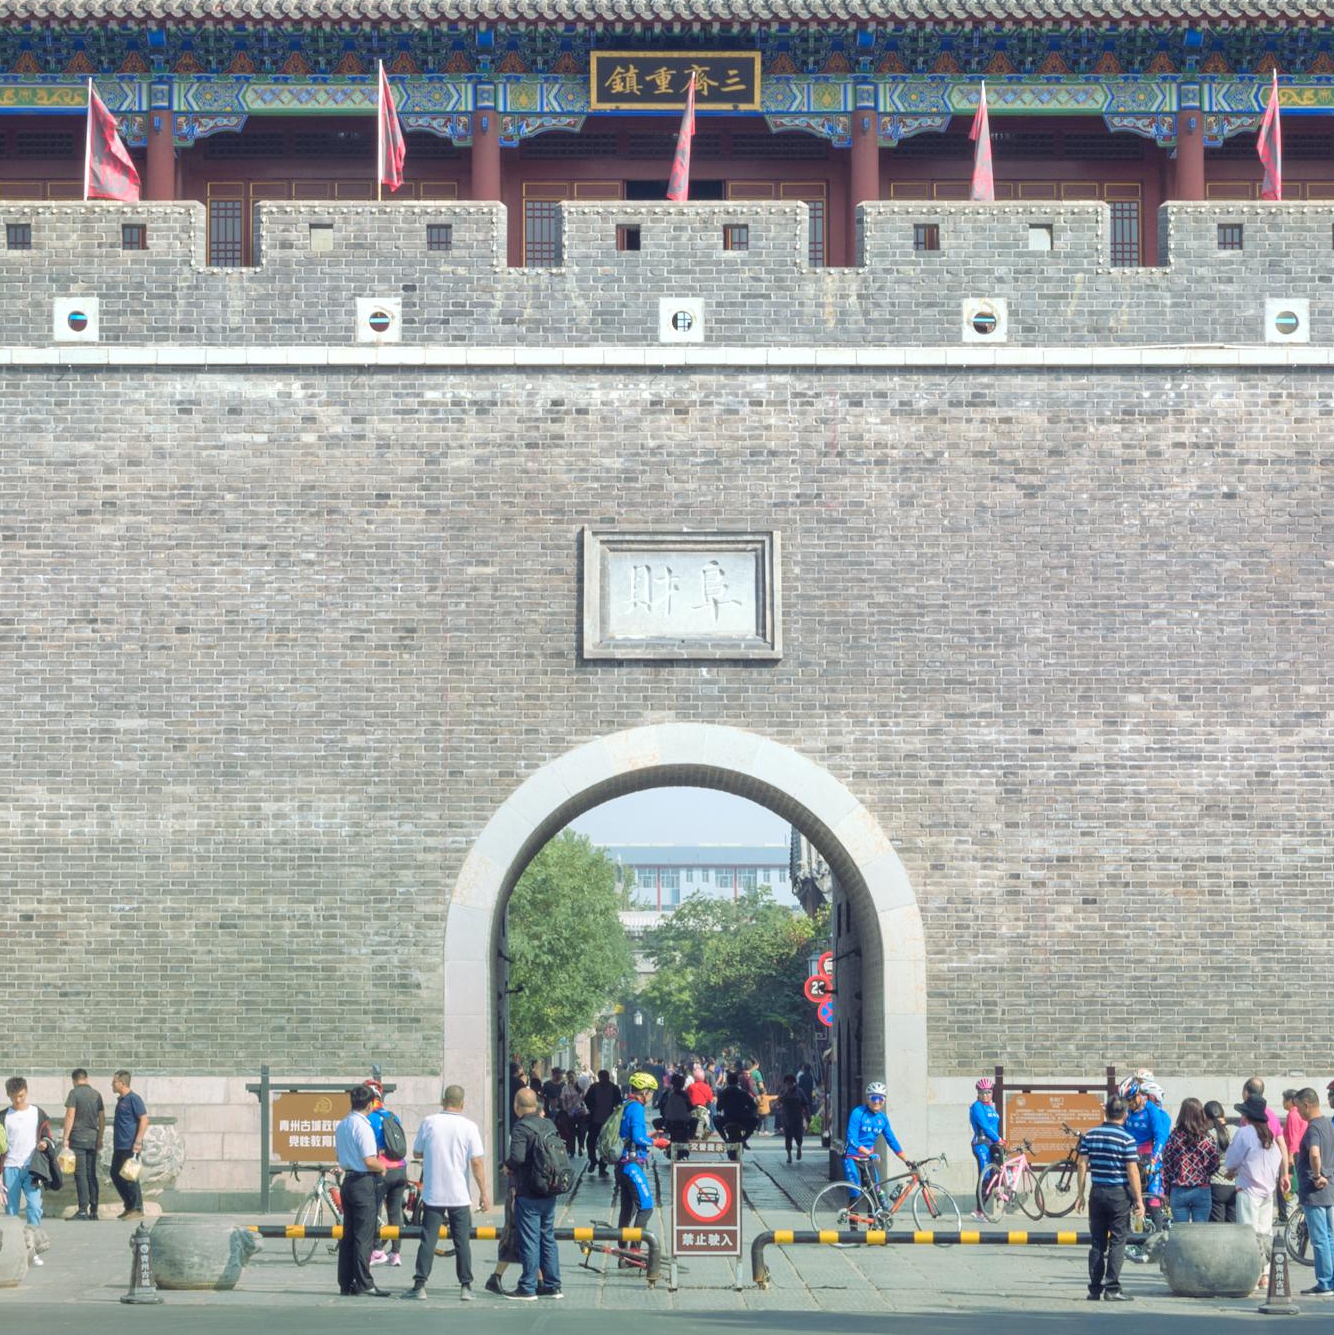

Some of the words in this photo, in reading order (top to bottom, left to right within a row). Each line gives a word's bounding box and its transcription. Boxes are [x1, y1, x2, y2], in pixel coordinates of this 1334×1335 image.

[289, 1135, 337, 1147] 党性教育
[682, 1232, 733, 1246] 禁止驶入
